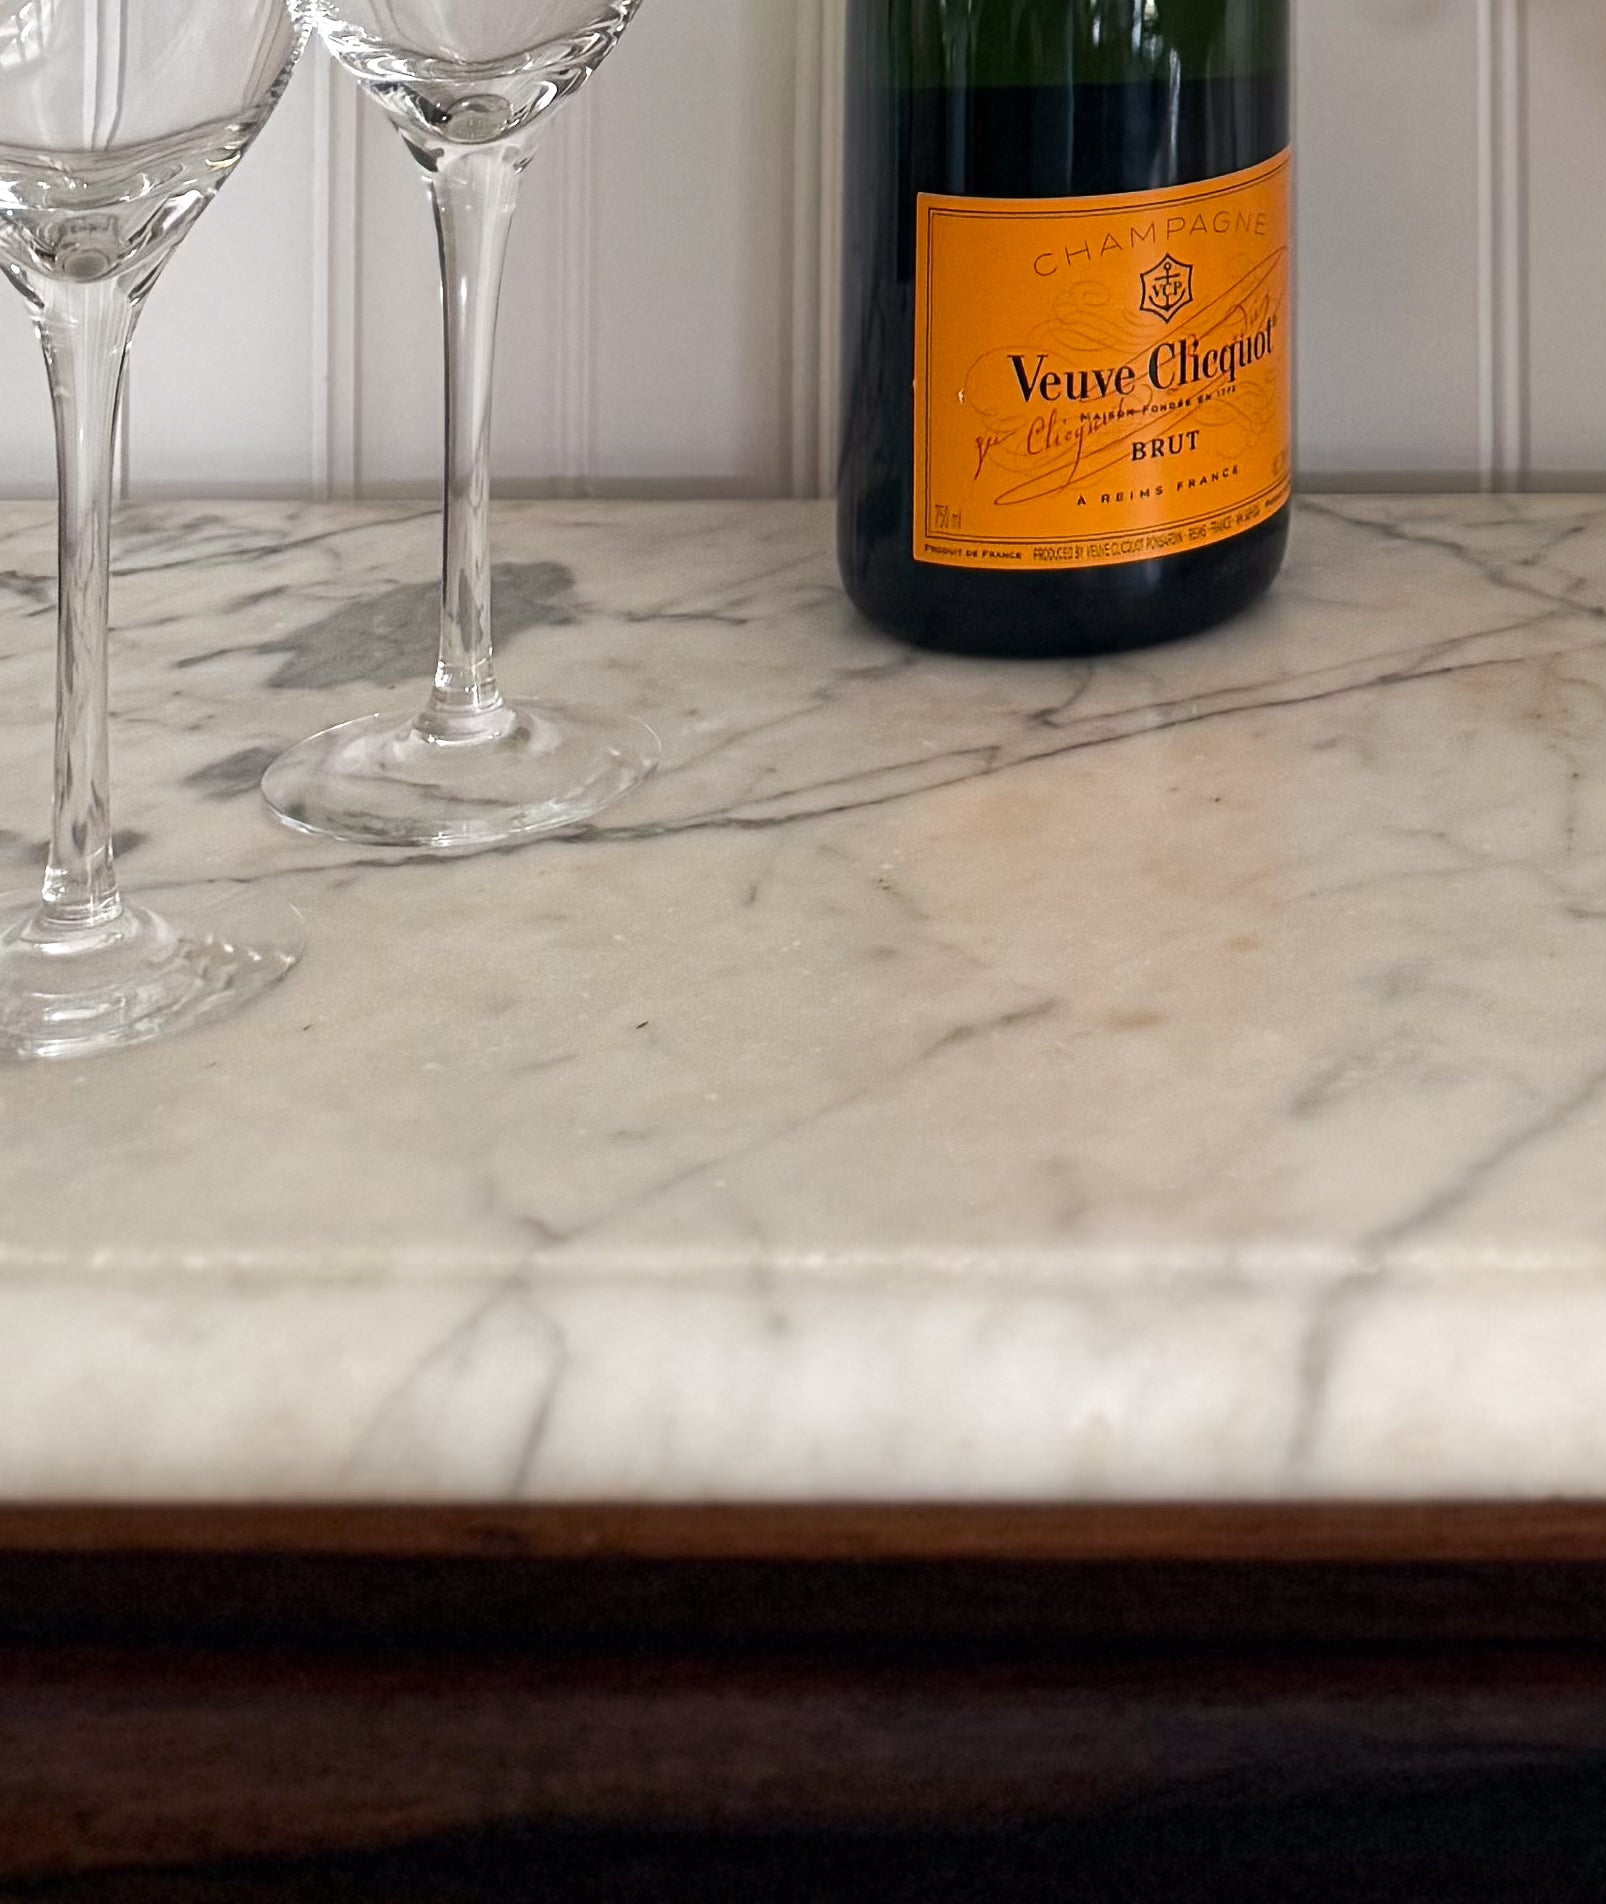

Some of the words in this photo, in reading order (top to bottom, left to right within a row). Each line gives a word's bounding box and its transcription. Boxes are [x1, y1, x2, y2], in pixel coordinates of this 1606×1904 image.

[1033, 210, 1267, 277] CHAMPAGNE
[1006, 354, 1136, 403] Veuve
[1148, 317, 1274, 391] Clicquot
[1131, 429, 1200, 462] BRUT
[1100, 485, 1164, 504] REIMS
[1176, 464, 1239, 492] FRANCE
[982, 549, 1022, 561] FRANCE
